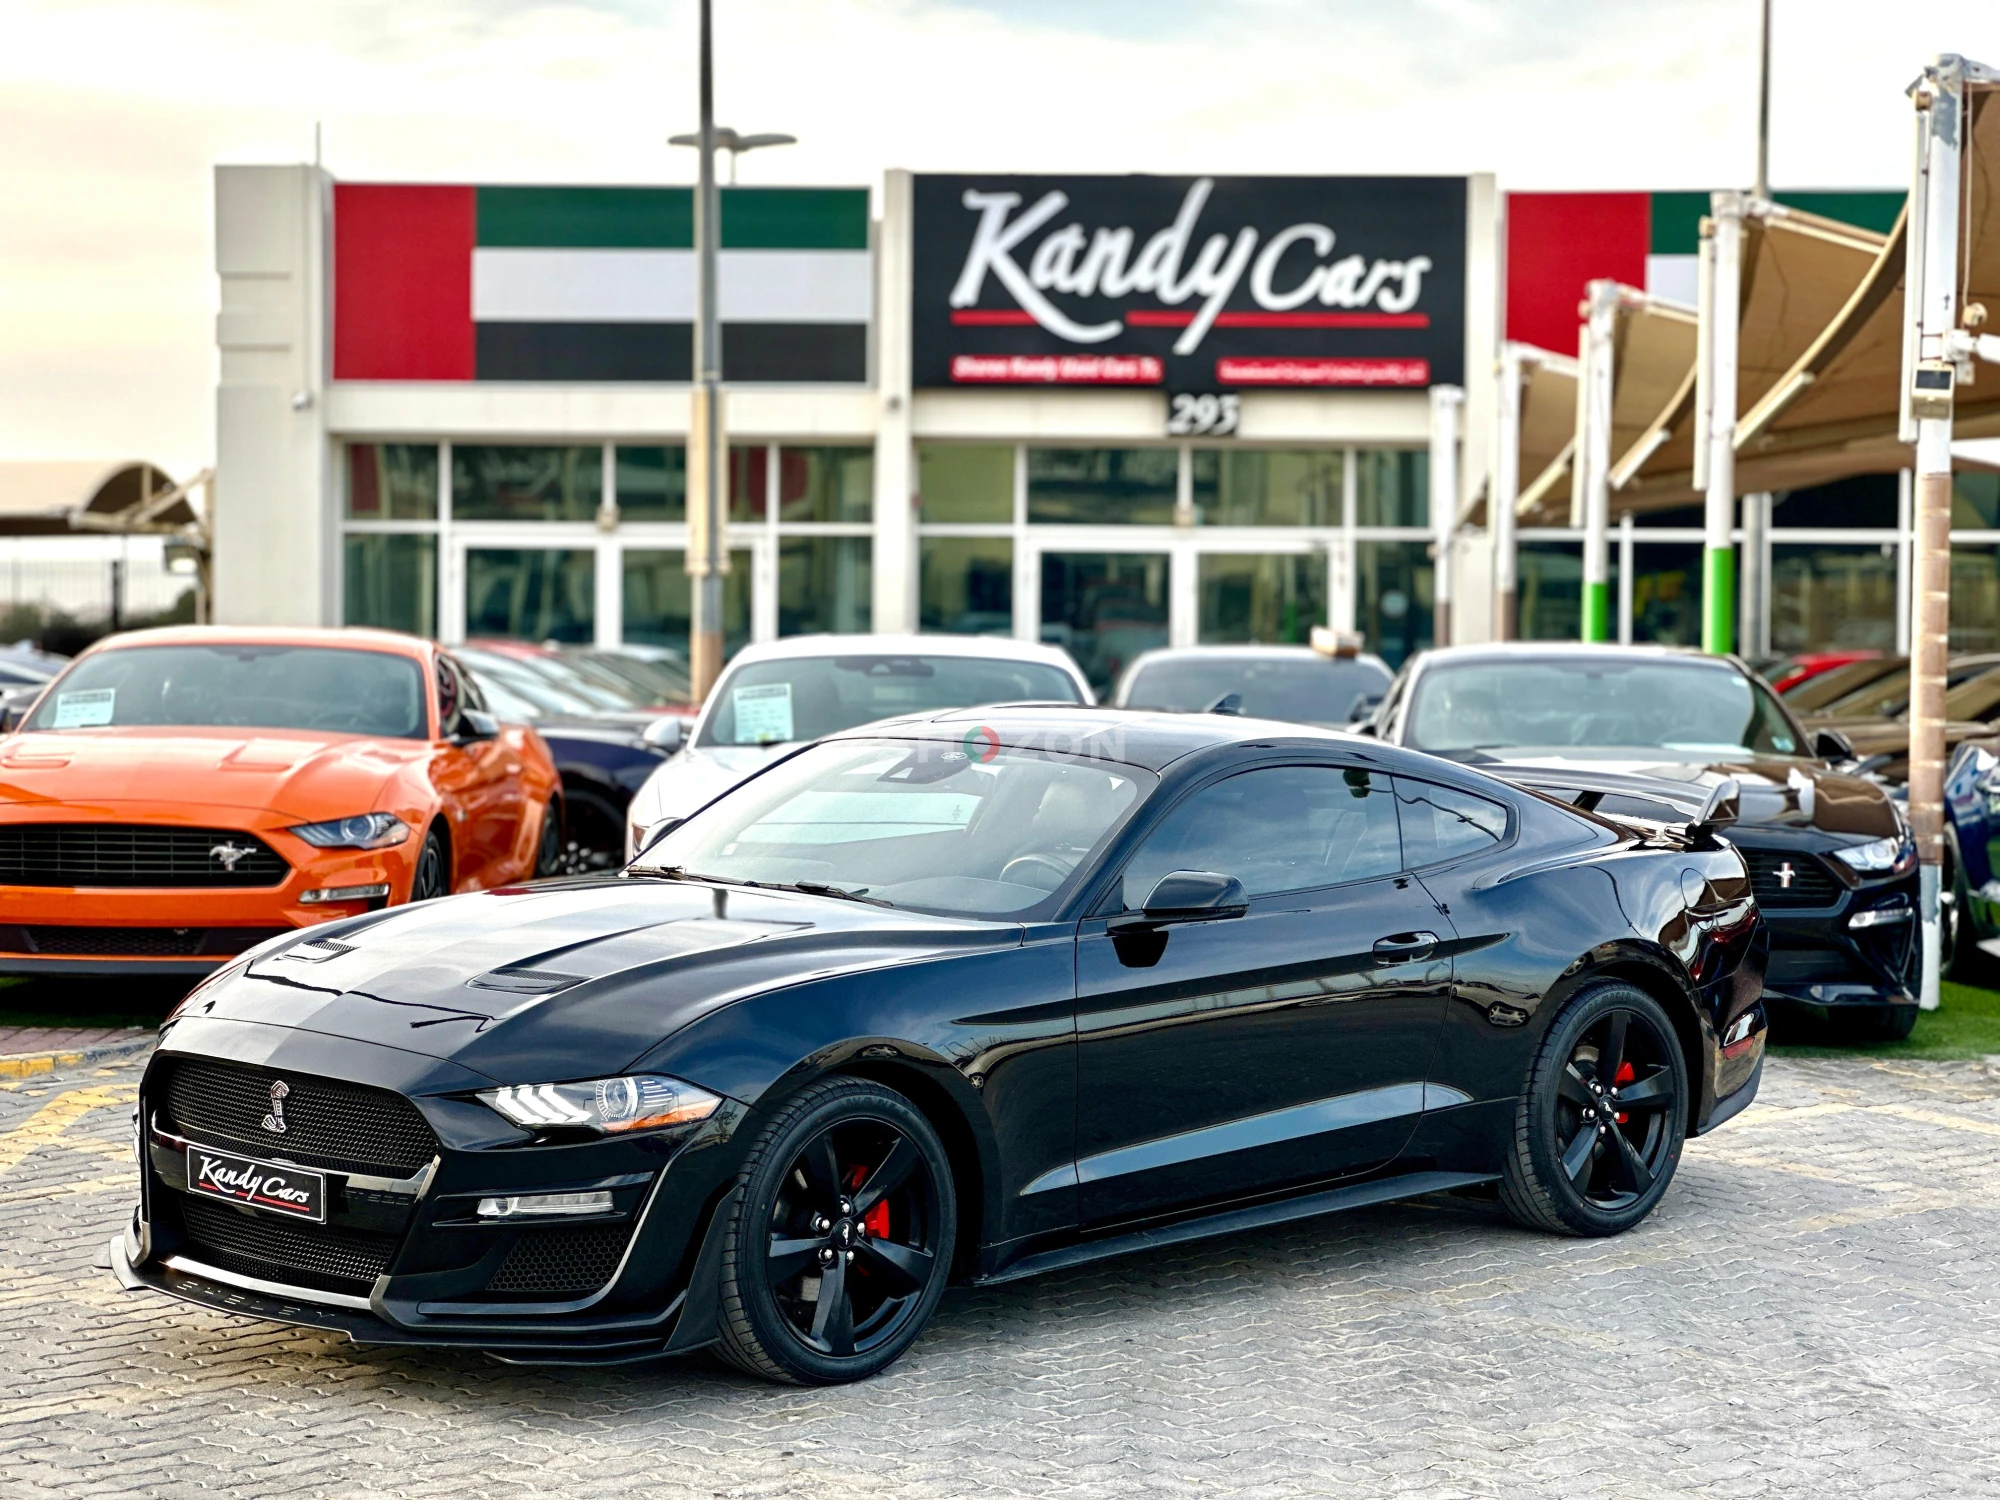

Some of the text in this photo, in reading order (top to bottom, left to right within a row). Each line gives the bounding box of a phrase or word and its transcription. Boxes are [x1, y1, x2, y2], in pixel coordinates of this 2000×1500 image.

[950, 178, 1431, 355] Kandy Cars
[1166, 393, 1242, 437] 295
[198, 1155, 310, 1203] Kandy Cars
